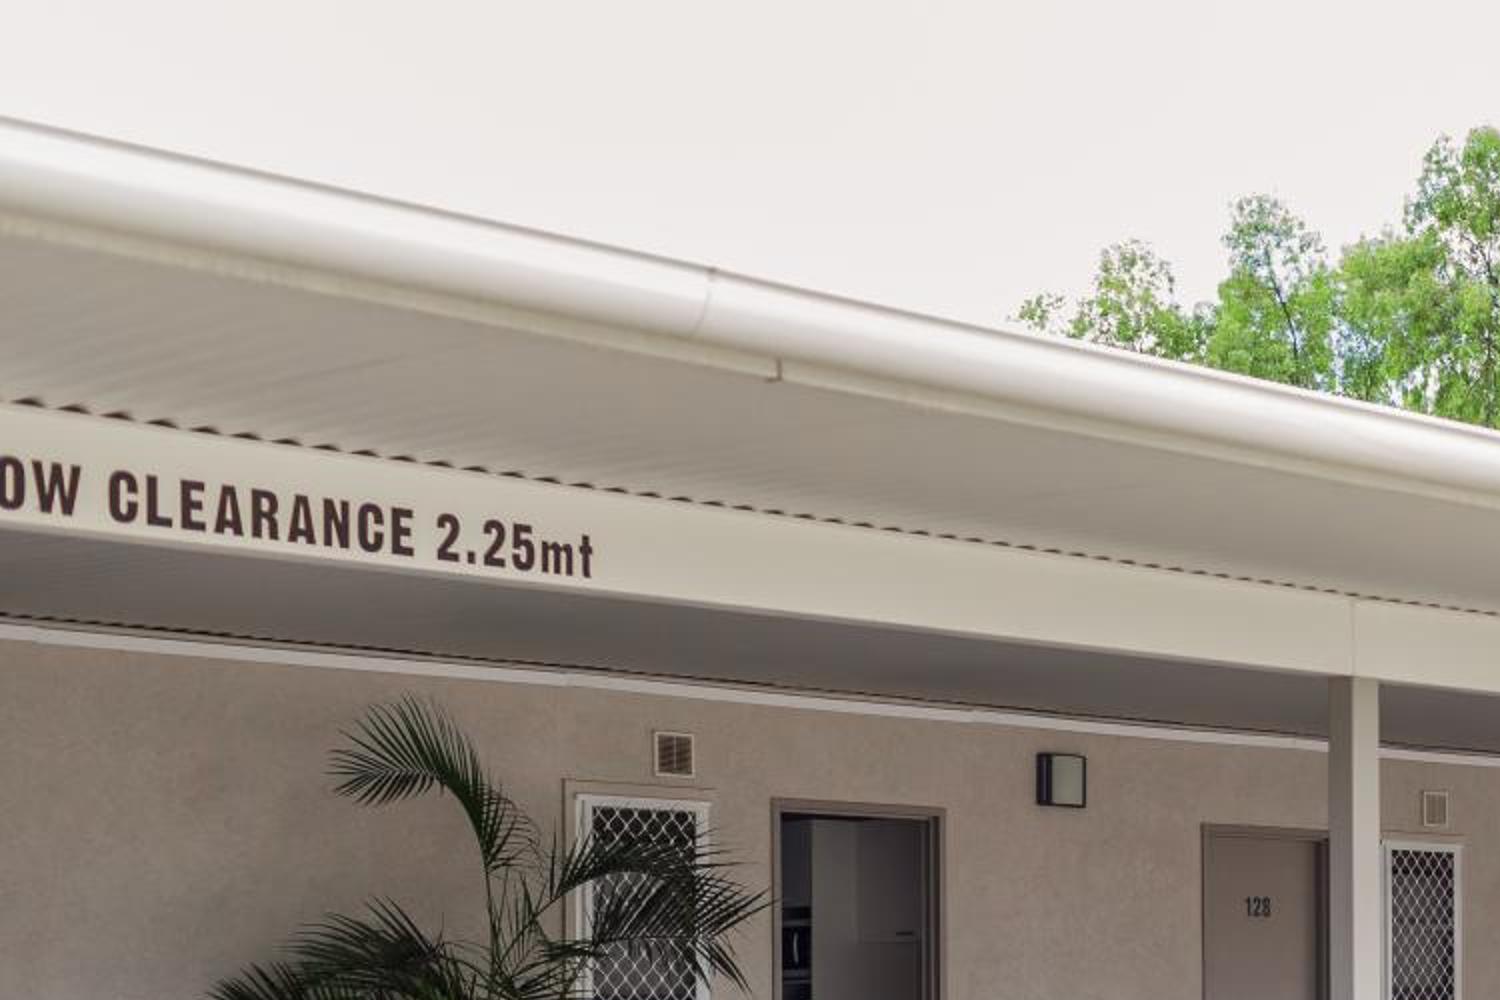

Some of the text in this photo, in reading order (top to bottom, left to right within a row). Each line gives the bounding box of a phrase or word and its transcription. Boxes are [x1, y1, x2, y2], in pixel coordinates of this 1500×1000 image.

[108, 469, 413, 556] CLEARANCE
[436, 512, 593, 577] 2.25mt
[1245, 896, 1271, 917] 128
